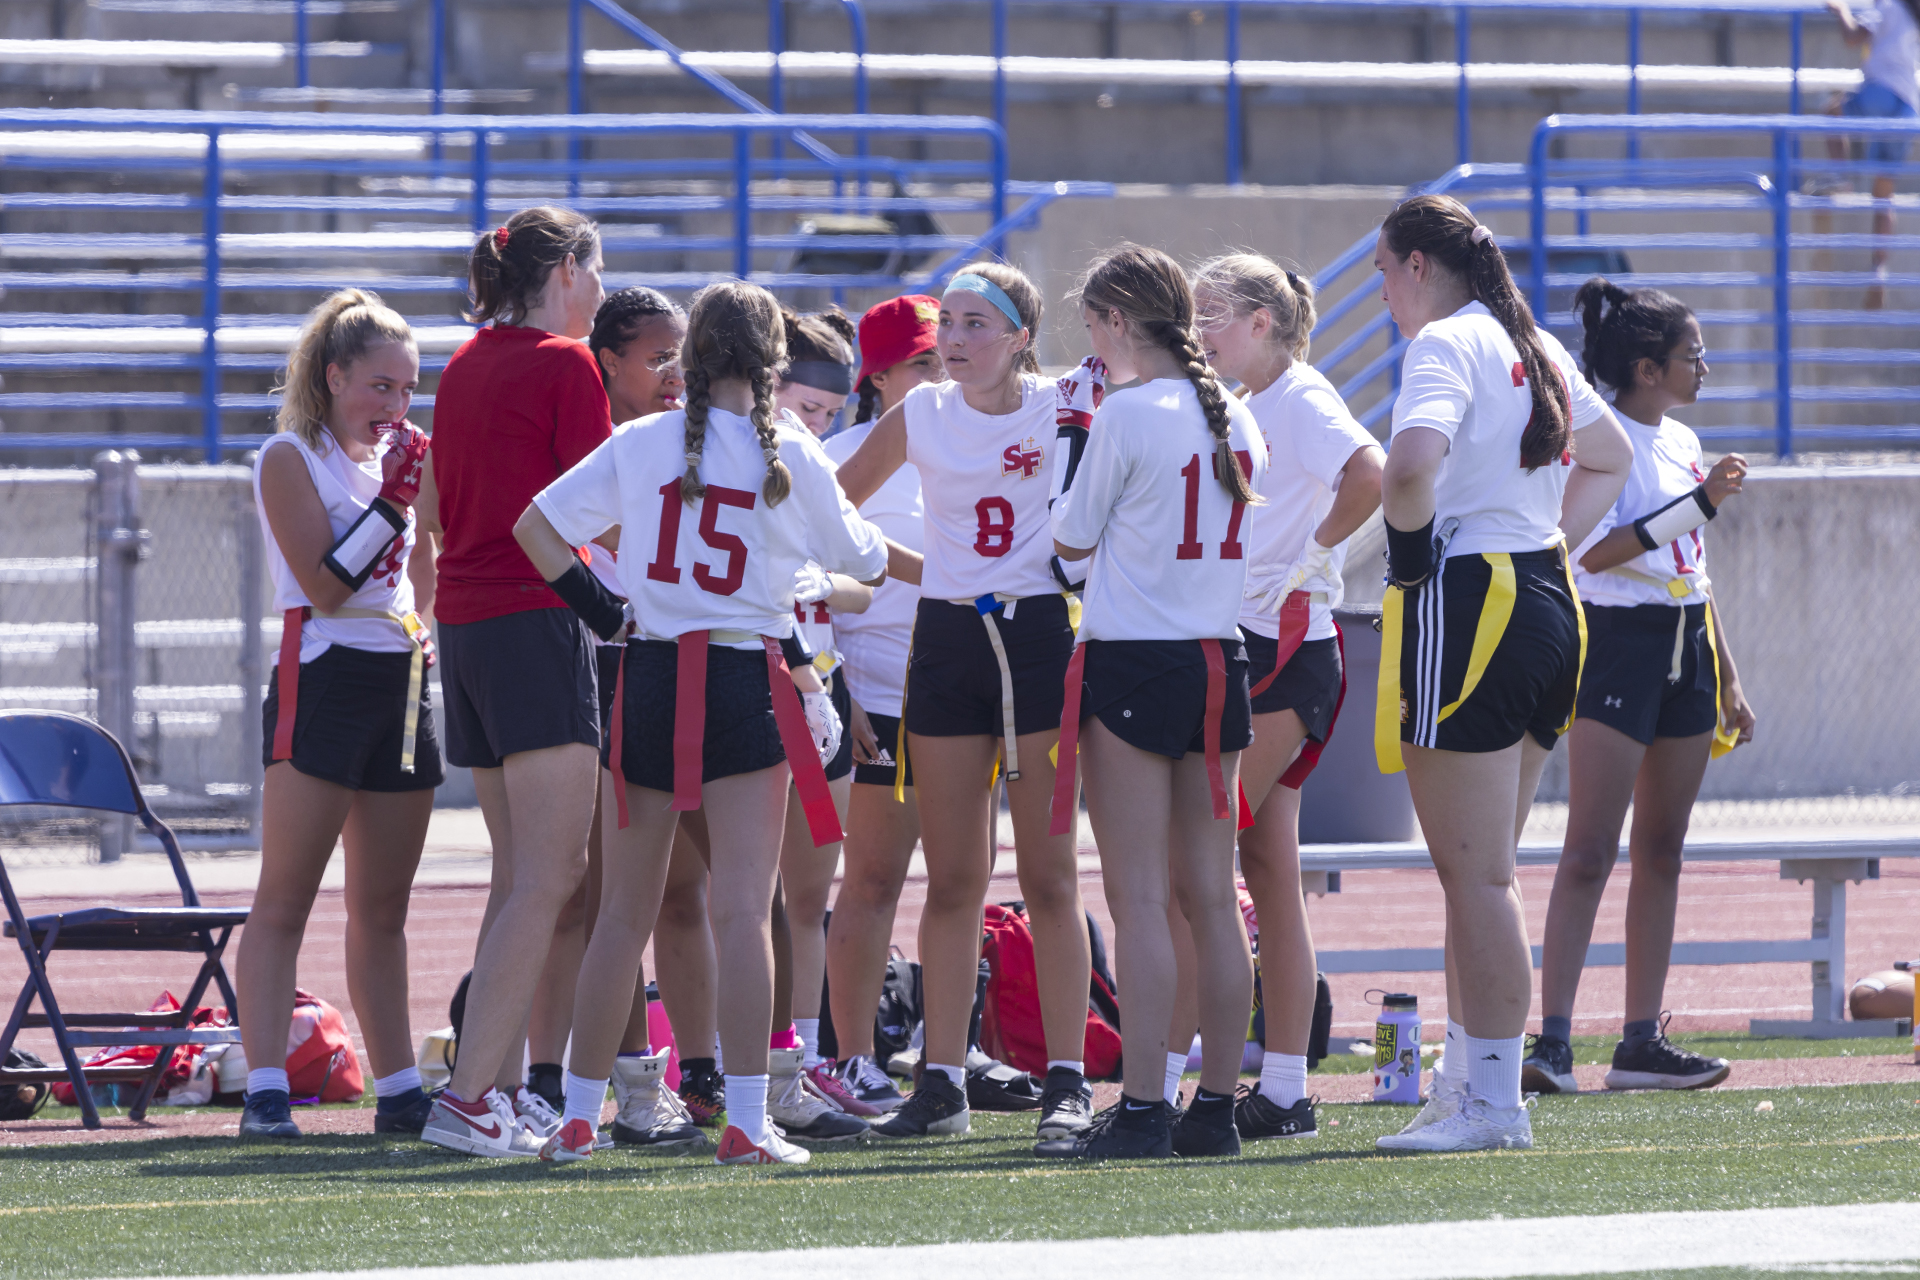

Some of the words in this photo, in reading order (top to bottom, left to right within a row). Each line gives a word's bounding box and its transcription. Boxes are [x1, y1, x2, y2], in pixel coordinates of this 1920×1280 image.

[1002, 441, 1043, 479] SF
[647, 475, 757, 597] 15
[973, 495, 1015, 558] 8
[1176, 450, 1254, 560] 17
